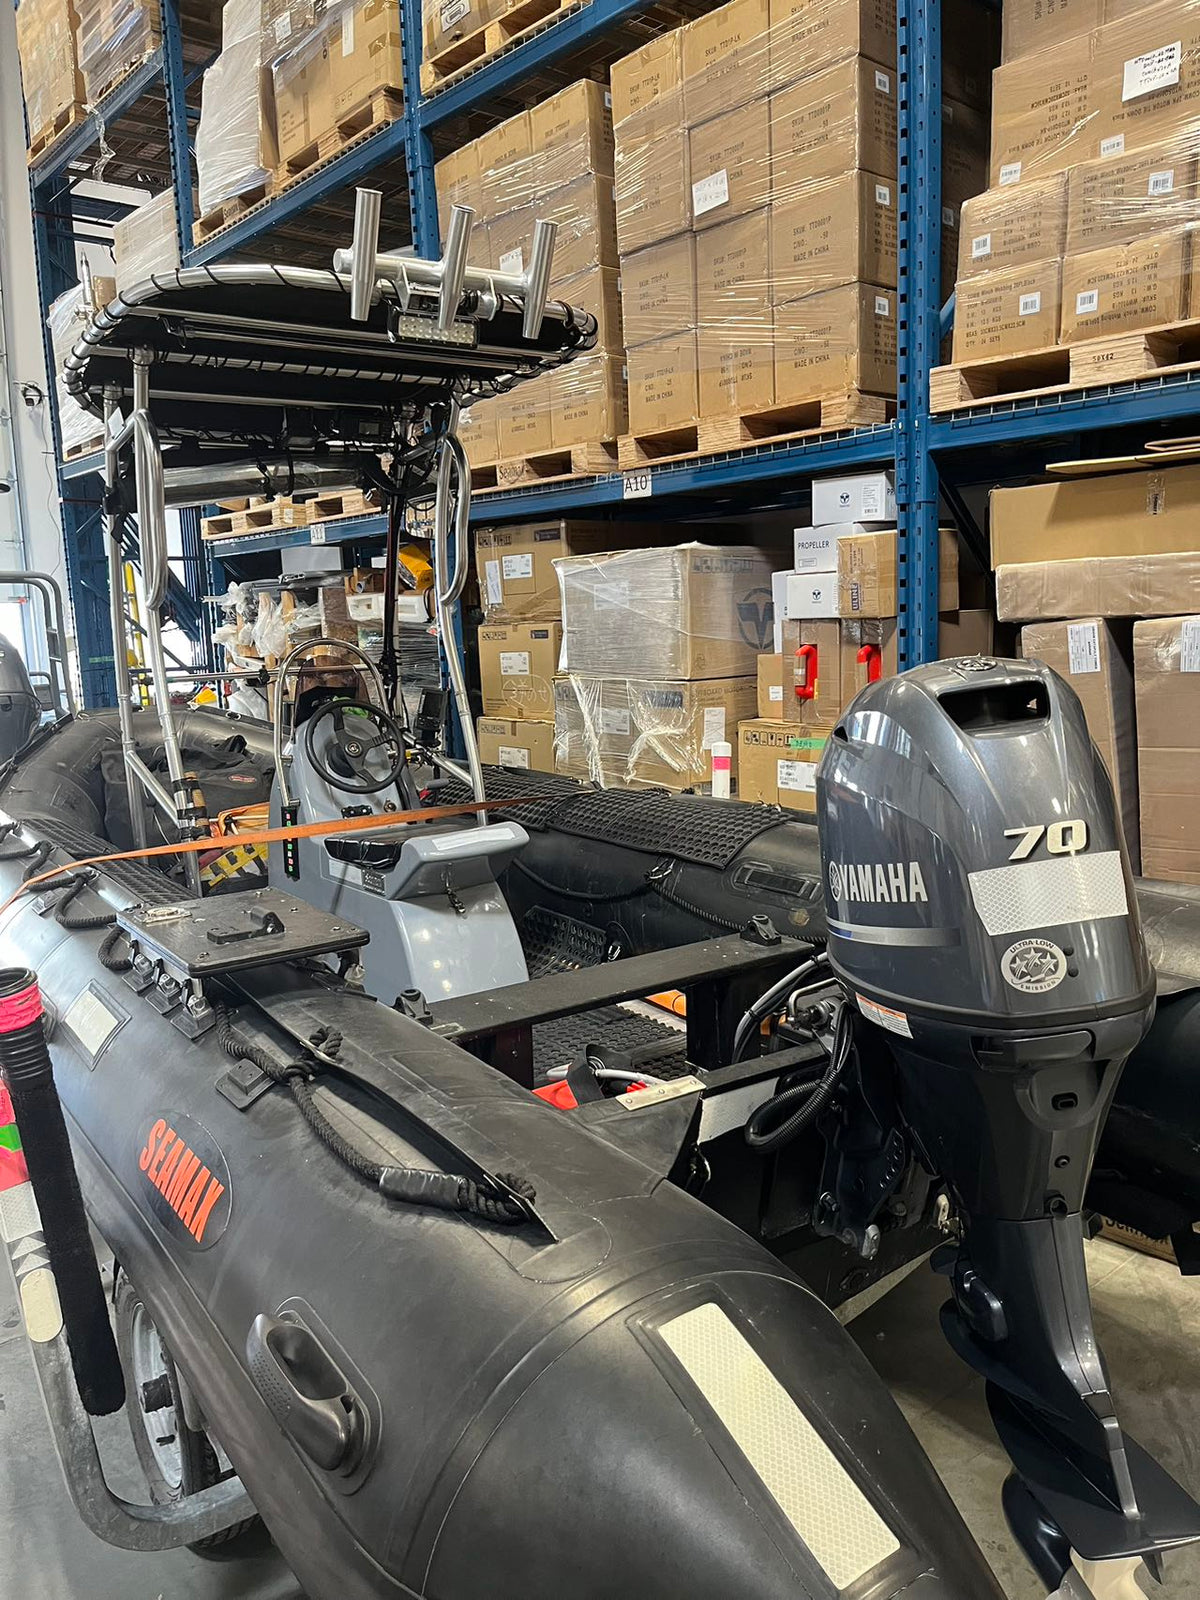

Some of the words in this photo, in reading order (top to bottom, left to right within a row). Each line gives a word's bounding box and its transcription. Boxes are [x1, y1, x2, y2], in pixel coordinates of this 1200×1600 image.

[794, 359, 808, 369] MADE
[815, 354, 831, 365] CHINA
[624, 474, 648, 493] A10
[797, 539, 830, 550] PROPELLER
[851, 583, 859, 612] ULINE
[1003, 819, 1088, 861] 70
[838, 861, 929, 903] YAMAHA
[1020, 980, 1057, 991] EMISSION
[139, 1118, 225, 1244] SEAMAX
